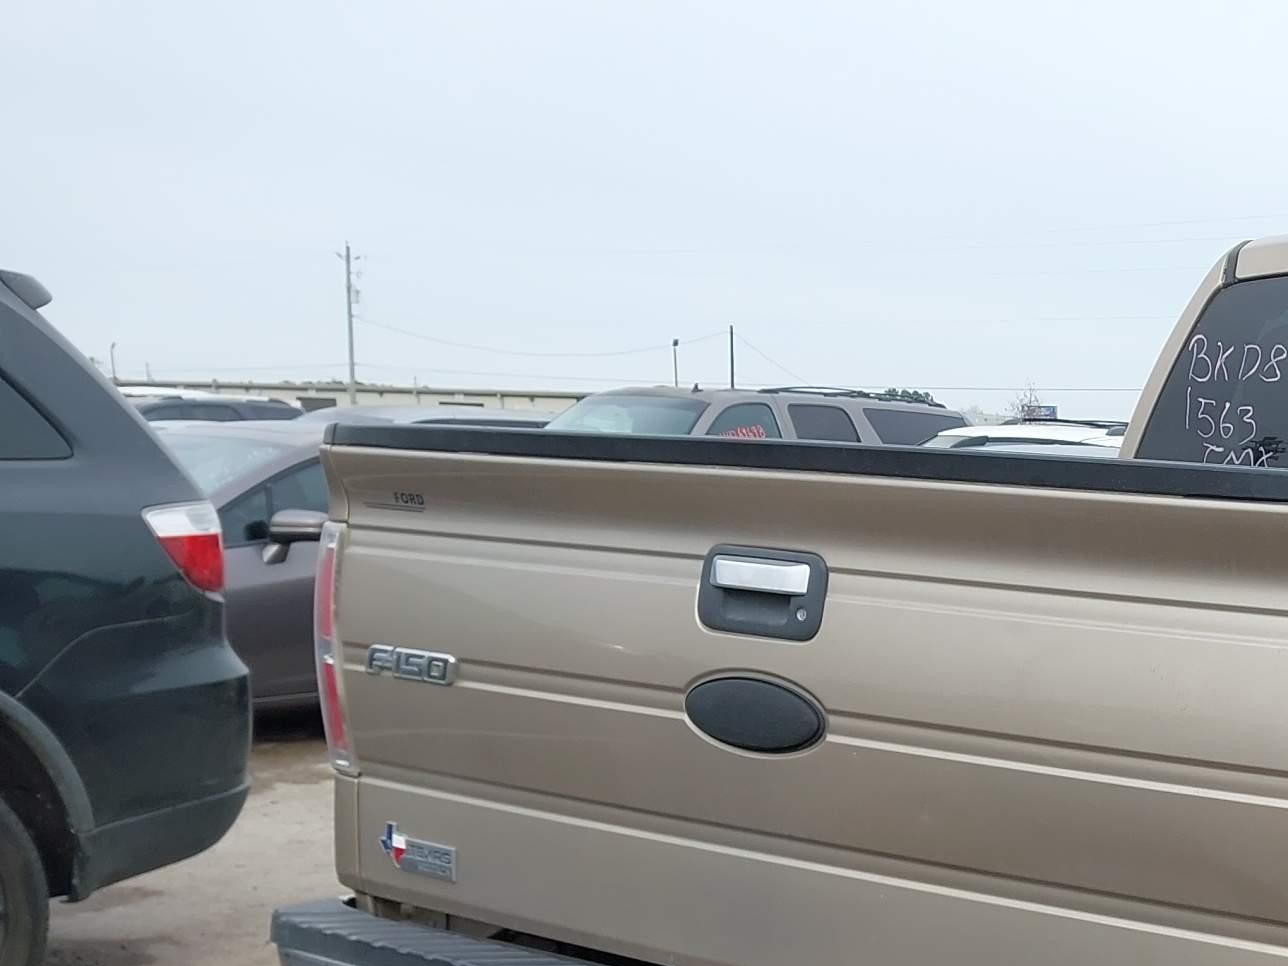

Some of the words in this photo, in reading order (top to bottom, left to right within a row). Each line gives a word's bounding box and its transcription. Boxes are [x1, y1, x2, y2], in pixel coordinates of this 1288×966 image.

[1188, 334, 1288, 382] BKD8
[1185, 386, 1256, 446] 1563
[393, 491, 425, 506] FORD
